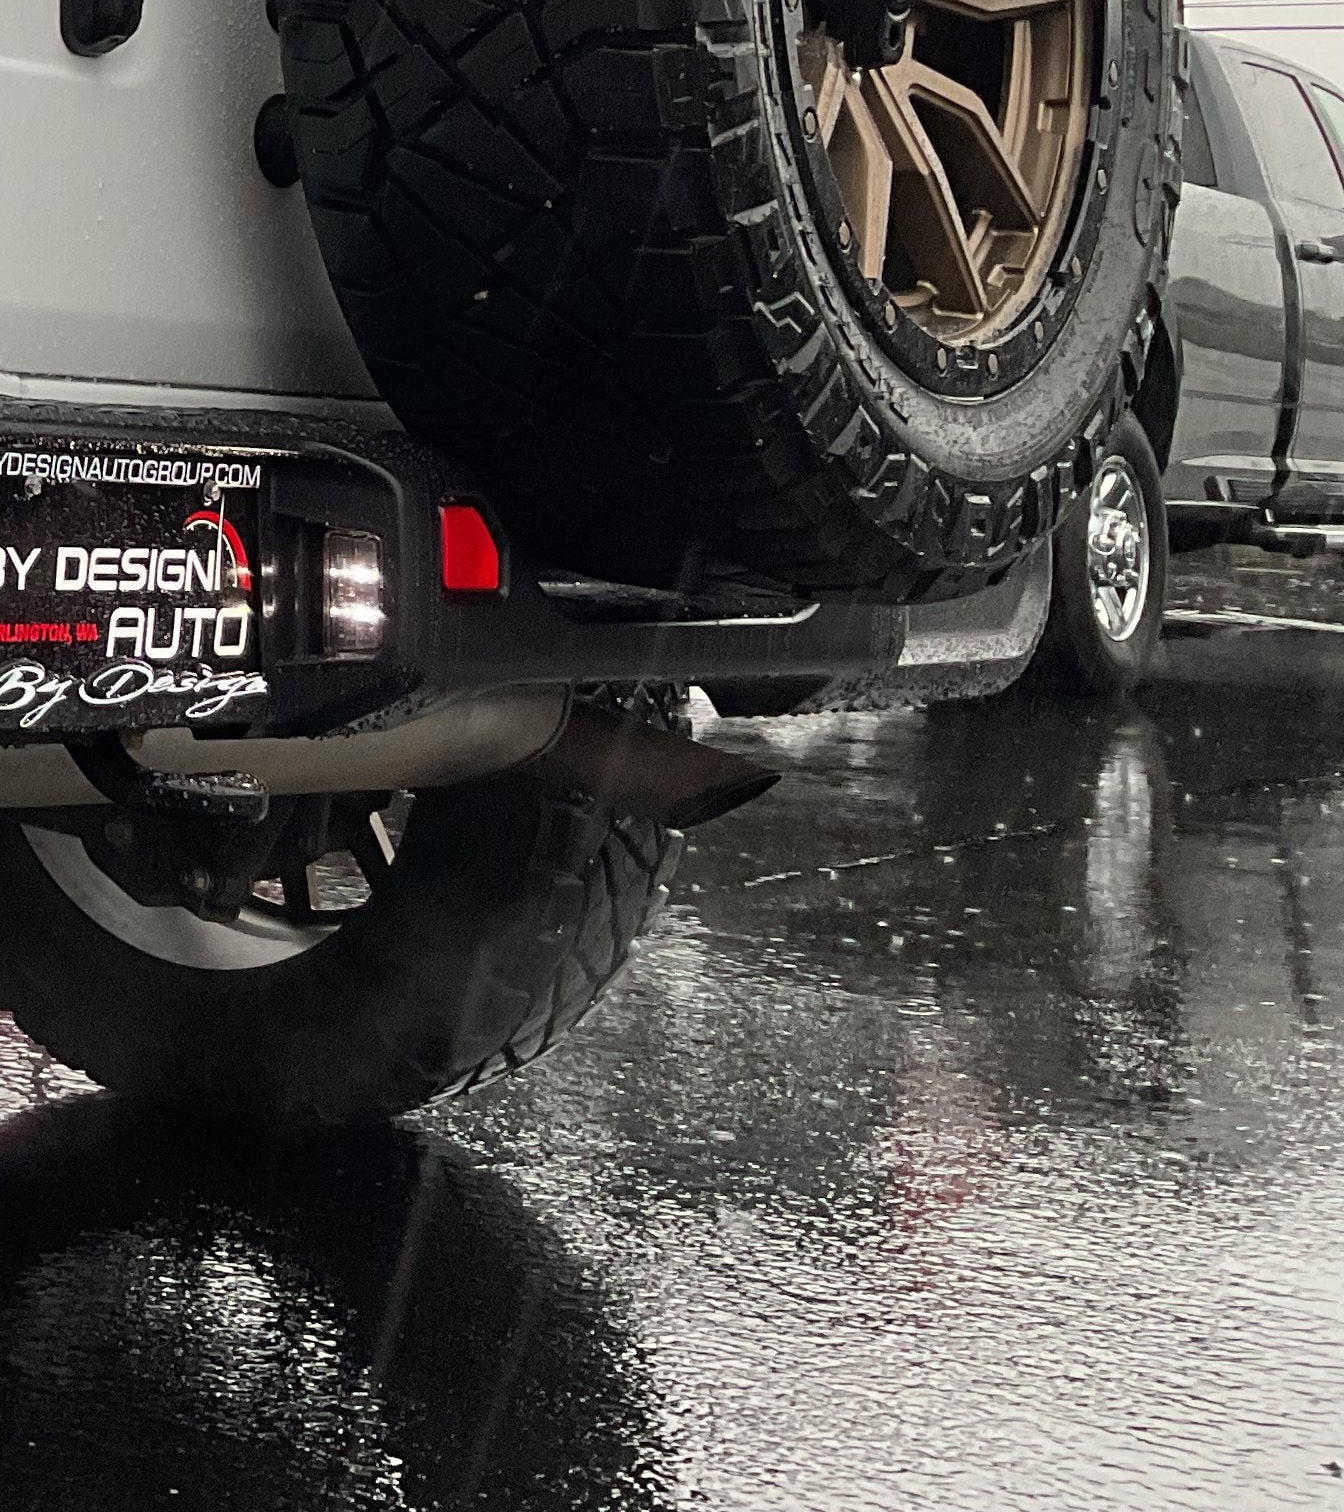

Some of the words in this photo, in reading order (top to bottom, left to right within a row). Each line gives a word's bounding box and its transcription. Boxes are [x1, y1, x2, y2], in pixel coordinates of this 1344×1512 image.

[55, 546, 223, 592] DESIGN
[76, 622, 99, 641] WA
[106, 606, 250, 659] AUTO
[79, 663, 268, 718] Design
